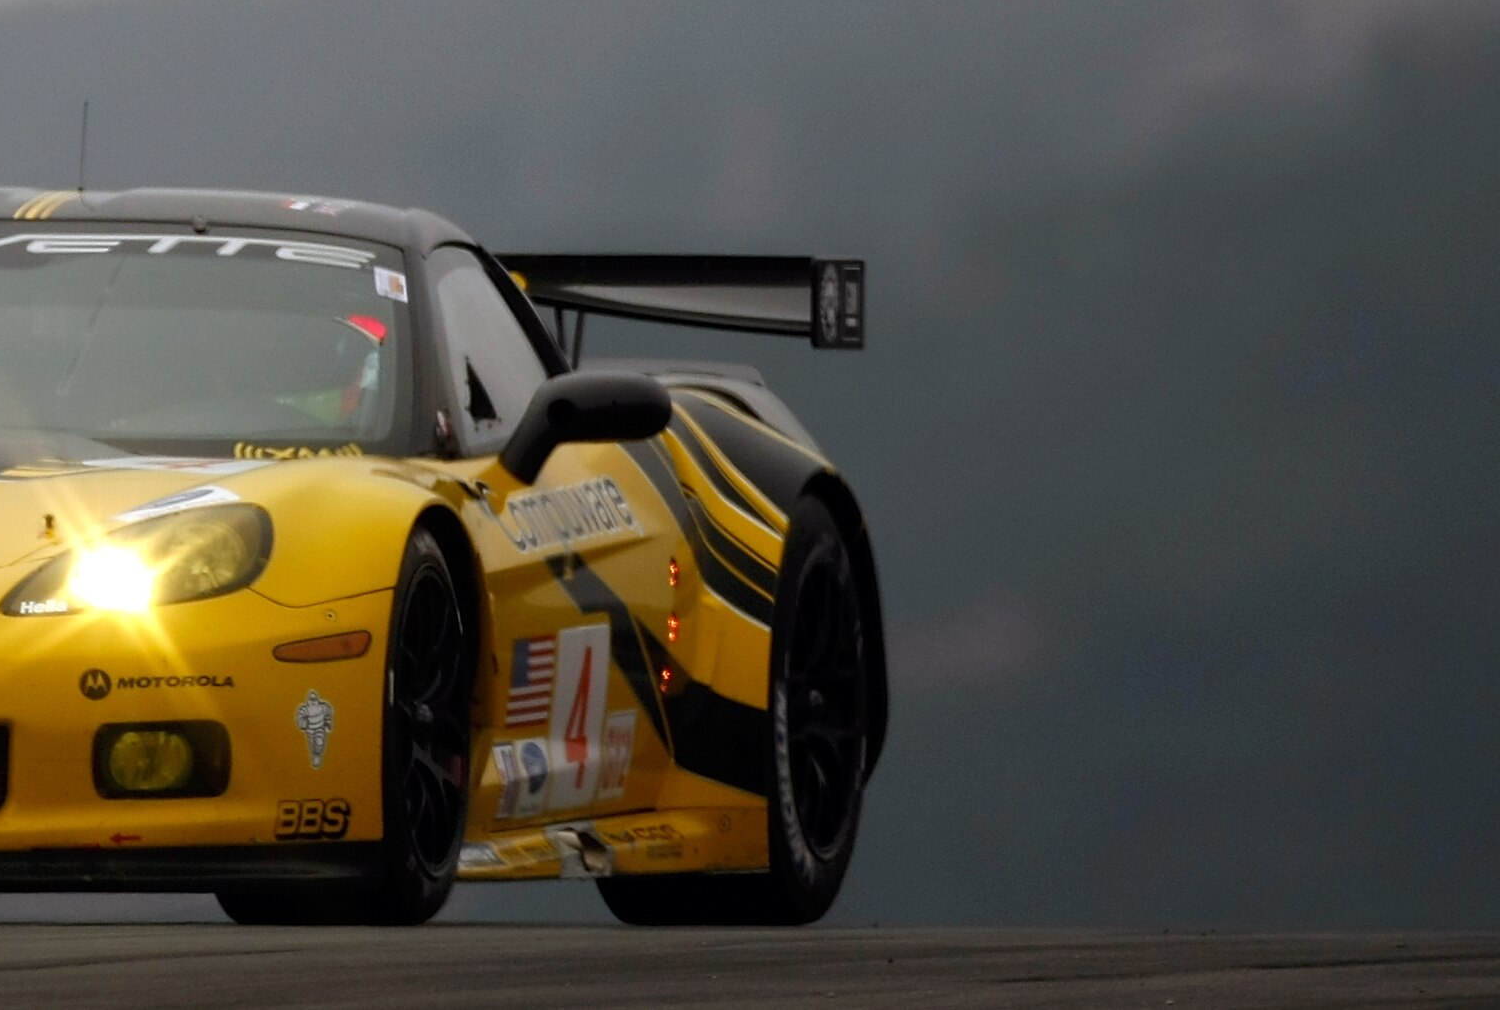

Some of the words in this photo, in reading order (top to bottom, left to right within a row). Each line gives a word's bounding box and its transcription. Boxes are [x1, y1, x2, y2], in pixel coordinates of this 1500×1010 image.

[117, 675, 236, 689] MOTOROLA
[564, 644, 594, 790] 4
[274, 798, 350, 840] BBS
